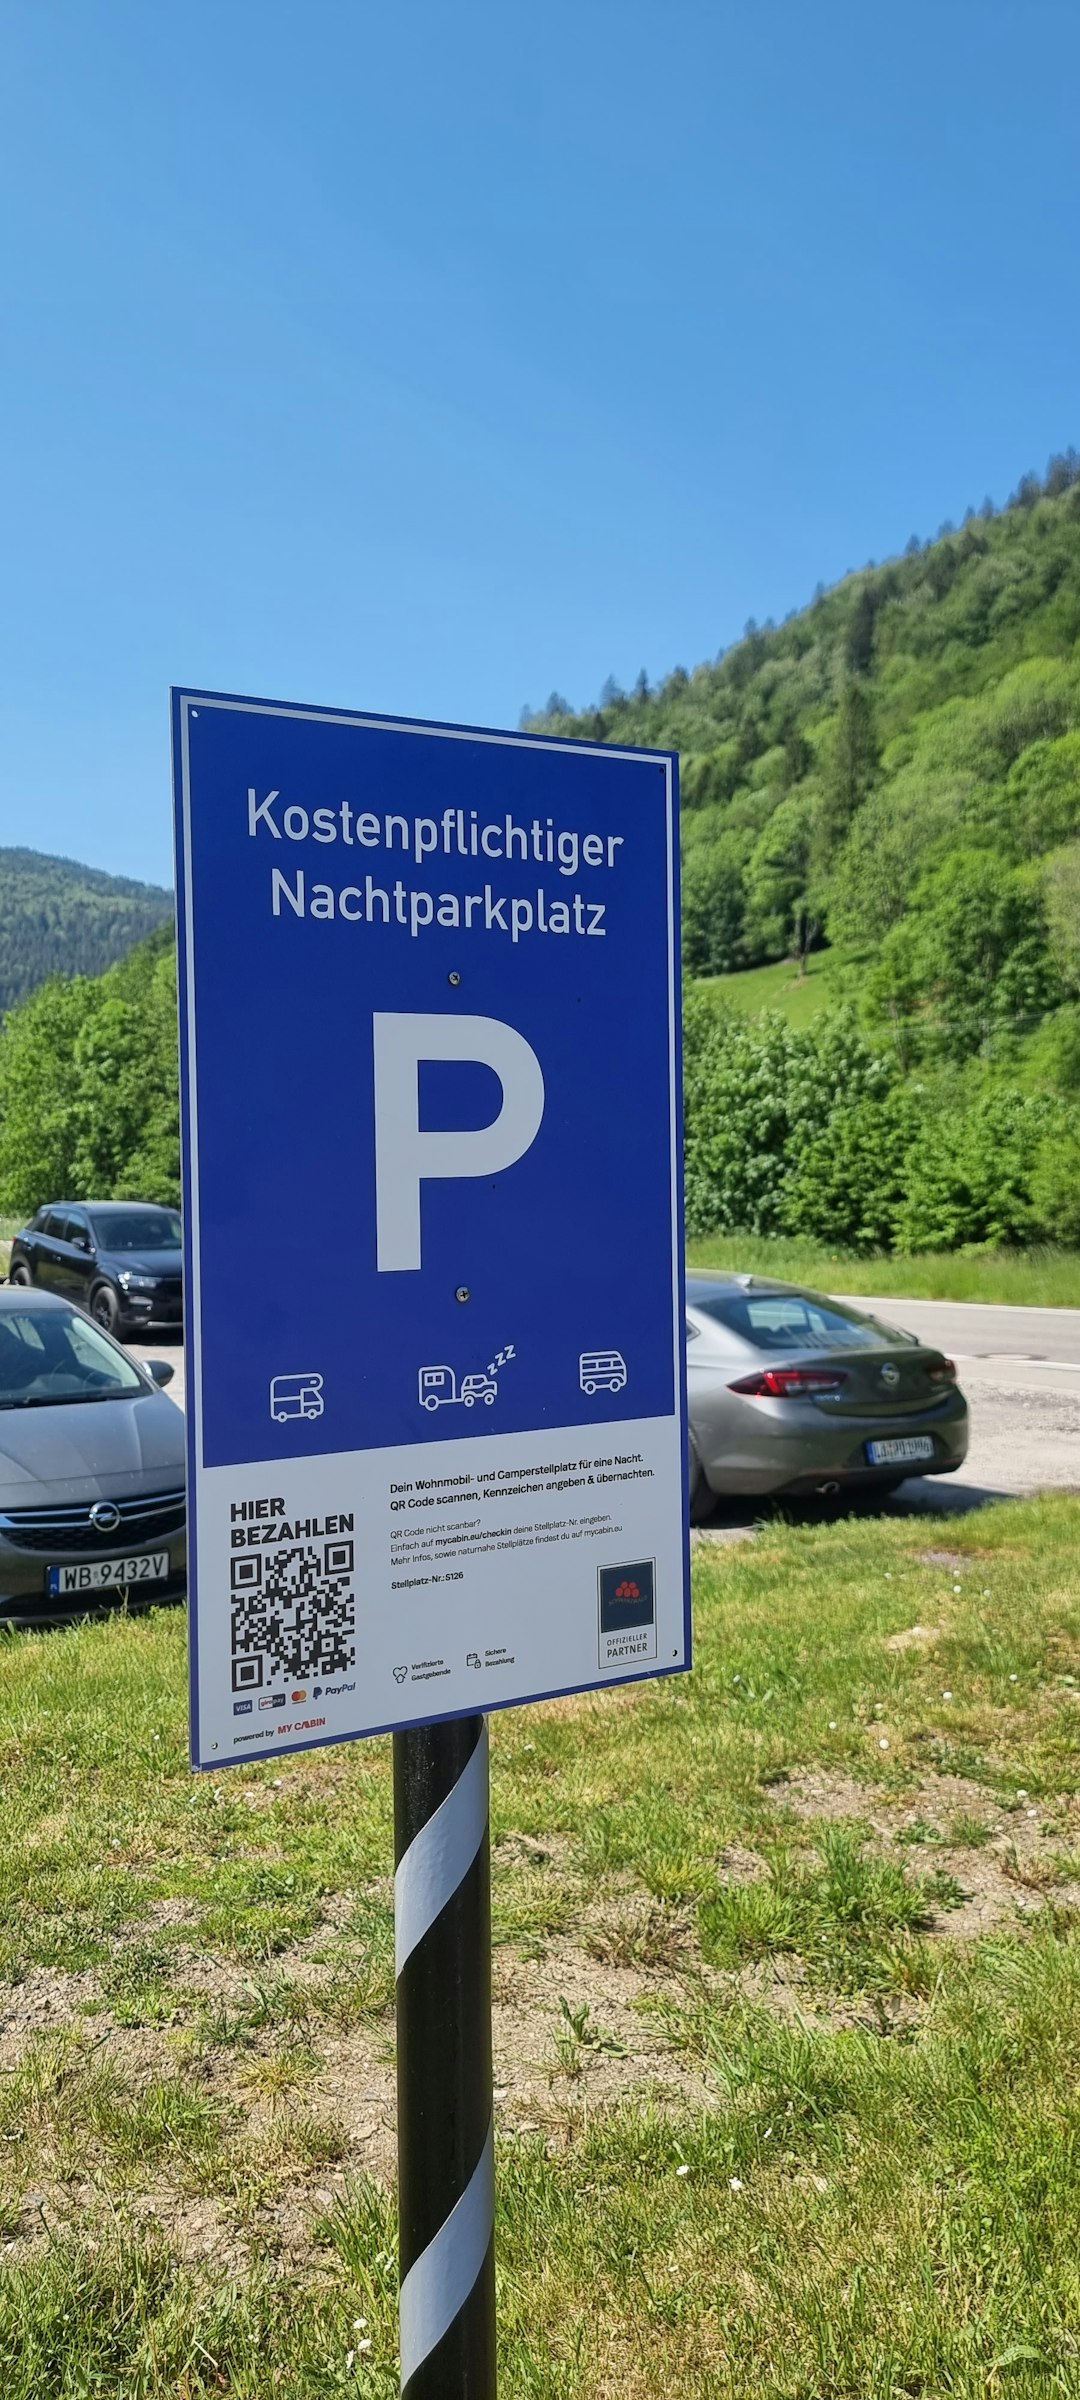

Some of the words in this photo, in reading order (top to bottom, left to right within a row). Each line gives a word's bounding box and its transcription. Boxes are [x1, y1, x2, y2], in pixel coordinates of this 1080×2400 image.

[247, 788, 624, 876] Kostenpflichtiger
[271, 868, 606, 943] Nachtparkplatz
[372, 1011, 545, 1273] P
[390, 1482, 413, 1494] Dein
[415, 1474, 474, 1490] Wohnmobil-
[477, 1471, 495, 1482] und
[497, 1462, 577, 1480] Camperstellplatz
[579, 1460, 592, 1469] für
[594, 1458, 612, 1467] eine
[614, 1454, 643, 1465] Nacht.
[390, 1501, 406, 1511] QR
[408, 1497, 435, 1508] Code
[437, 1492, 481, 1505] scannen,
[483, 1483, 543, 1498] Kennzeichen
[546, 1478, 586, 1491] angeben
[587, 1475, 595, 1484] &
[596, 1469, 655, 1483] übernachten.
[230, 1497, 286, 1522] HIER
[230, 1513, 354, 1548] BEZAHLEN
[390, 1530, 403, 1539] QR
[404, 1528, 425, 1537] Code
[426, 1525, 446, 1534] nicht
[446, 1519, 481, 1531] scanbar?
[391, 1541, 419, 1553] Einfach
[421, 1539, 434, 1548] auf
[435, 1527, 512, 1546] mycabin.eu/checkin
[513, 1526, 533, 1535] deine
[534, 1519, 579, 1532] Stellplatz-Nr.
[579, 1514, 612, 1525] eingeben.
[391, 1556, 410, 1566] Mehr
[412, 1553, 433, 1562] Infos,
[434, 1550, 456, 1559] sowie
[458, 1544, 495, 1556] naturnahe
[496, 1538, 534, 1550] Stellplätze
[535, 1534, 560, 1544] findest
[561, 1532, 570, 1540] du
[571, 1530, 583, 1538] auf
[584, 1525, 623, 1538] mycabin.eu
[64, 1567, 91, 1590] WB
[100, 1555, 164, 1585] 9432V
[606, 1632, 648, 1646] OFFIZIELLER
[607, 1642, 648, 1658] PARTNER
[411, 1659, 444, 1670] Verifizierte
[484, 1648, 507, 1657] Sichere
[485, 1656, 515, 1668] Bezahlung
[411, 1668, 451, 1681] Gastgebende
[325, 1682, 356, 1696] PayPal
[235, 1703, 251, 1712] VISA
[233, 1730, 264, 1744] powered
[265, 1729, 275, 1739] by
[277, 1724, 292, 1735] MY
[294, 1717, 326, 1731] CABIN
